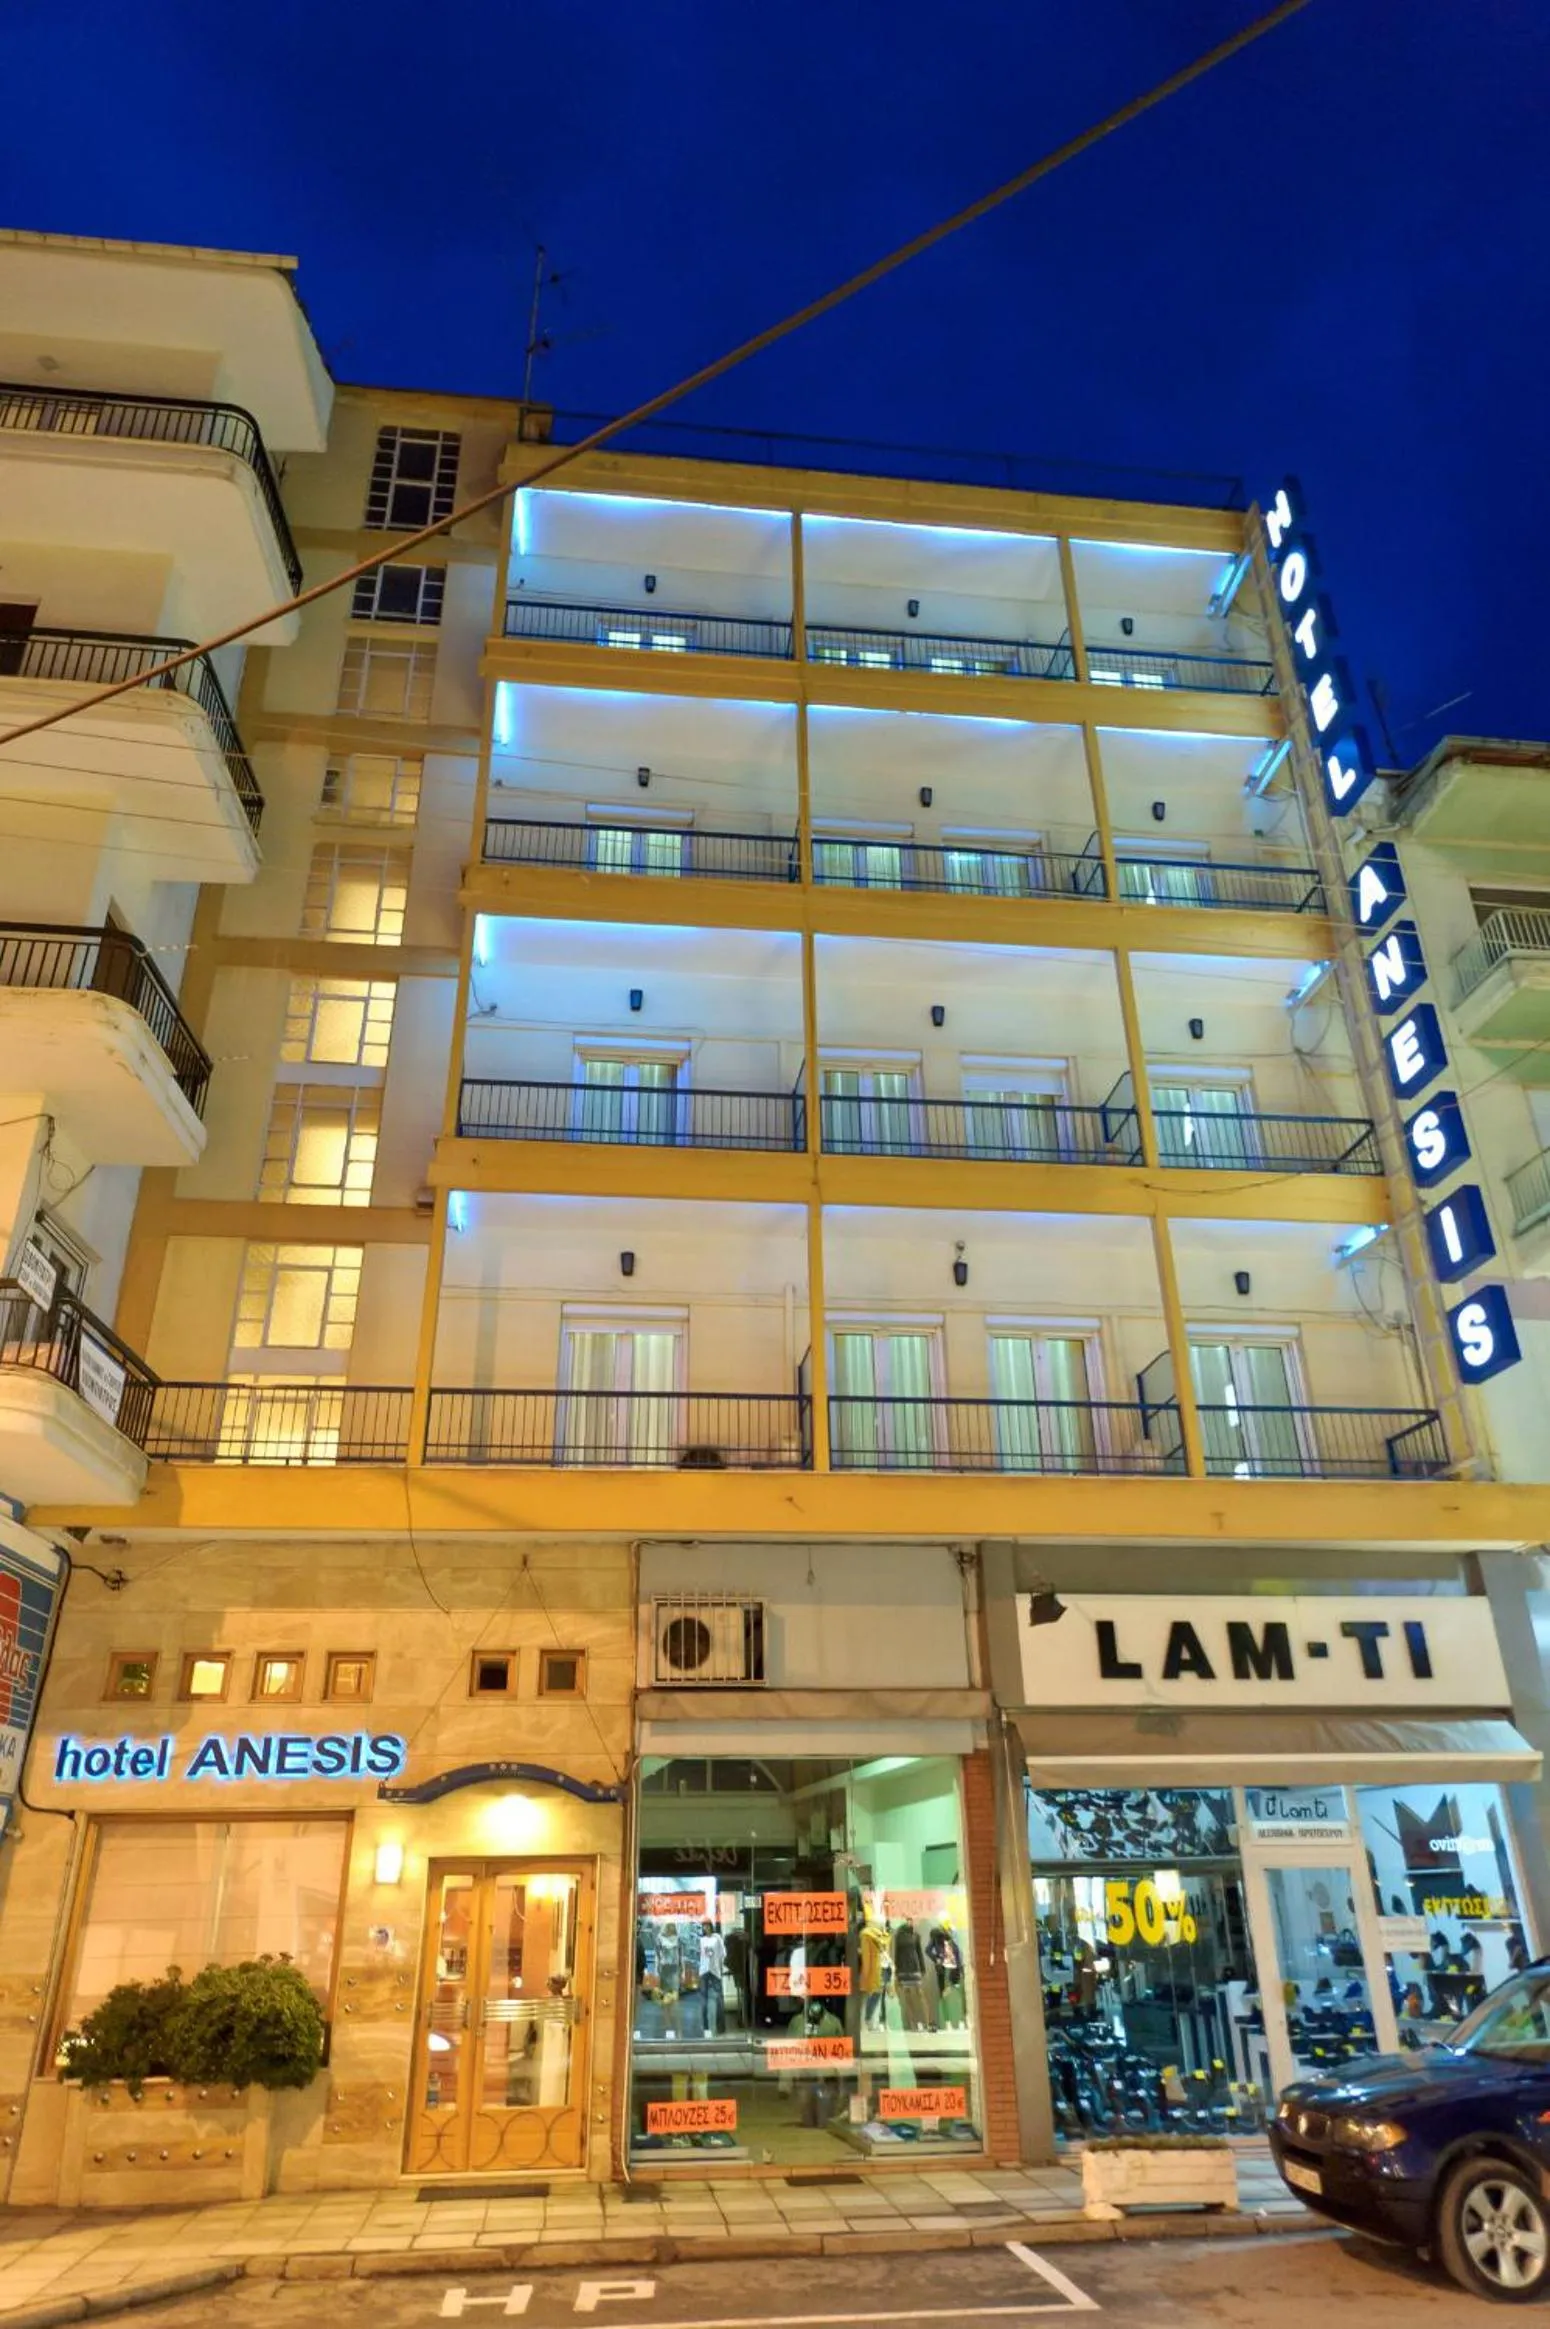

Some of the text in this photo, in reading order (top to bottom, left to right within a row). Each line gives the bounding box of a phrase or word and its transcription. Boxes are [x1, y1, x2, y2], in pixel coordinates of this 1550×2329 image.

[1266, 489, 1357, 800] HOTEL
[1357, 864, 1494, 1368] ANESIS
[55, 1734, 402, 1781] hotel ANESIS
[767, 1900, 845, 1924] ΕΚΠΤΩΣΕΙΣ
[1105, 1879, 1197, 1947] 50%
